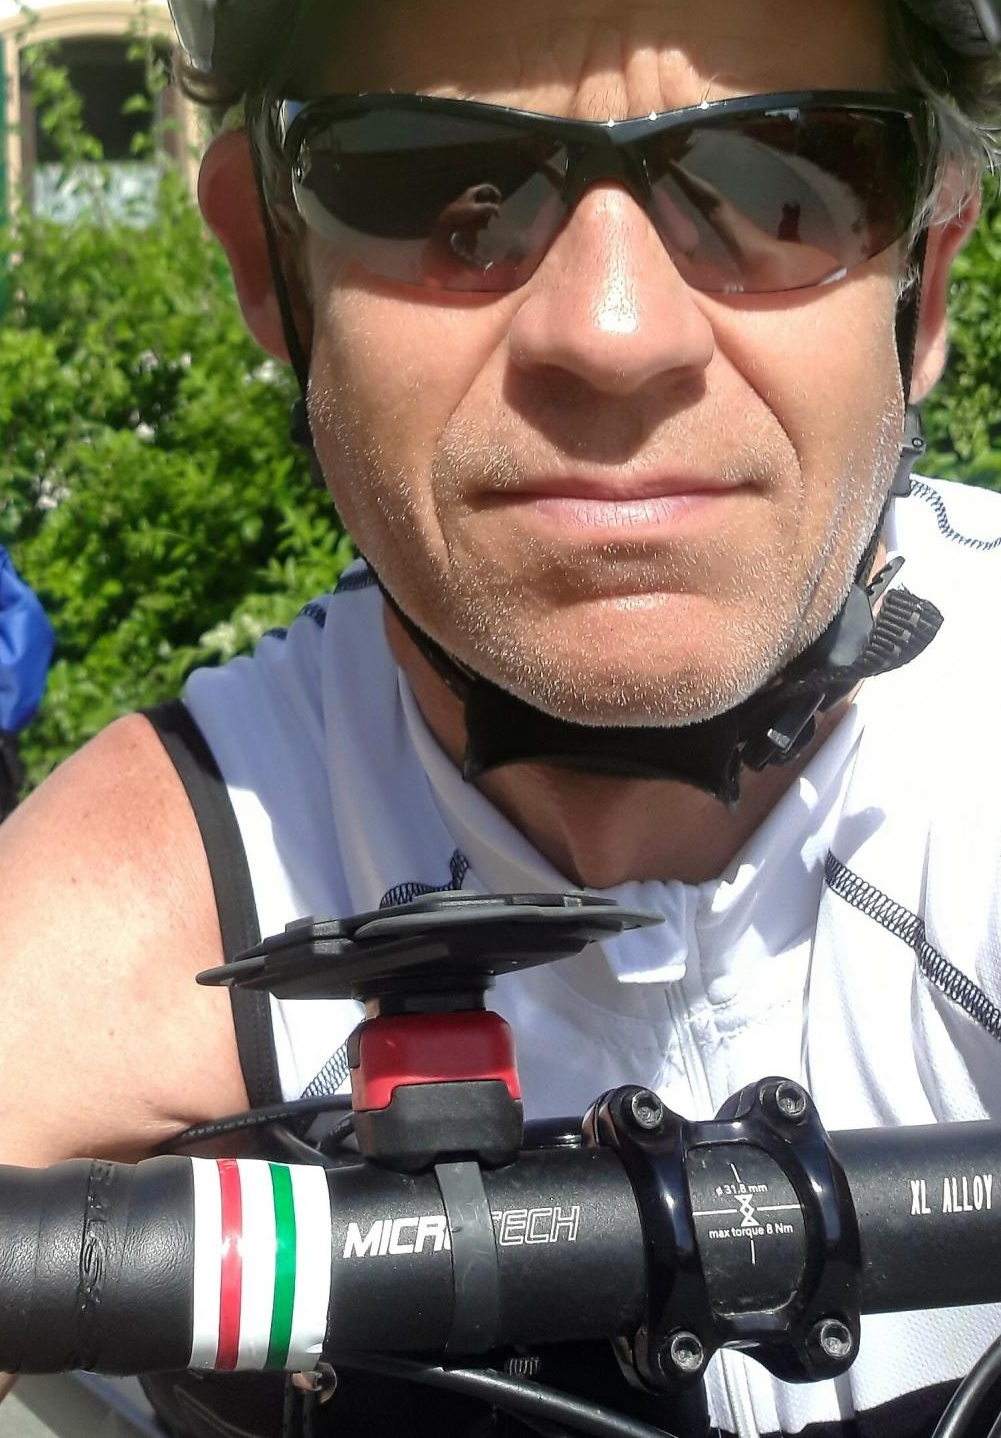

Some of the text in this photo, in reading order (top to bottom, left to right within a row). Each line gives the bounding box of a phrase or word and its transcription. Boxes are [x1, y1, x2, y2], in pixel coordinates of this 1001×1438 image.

[748, 1184, 768, 1193] mm
[910, 1174, 993, 1215] XL ALLOY
[709, 1222, 793, 1239] max torque 8 Nm
